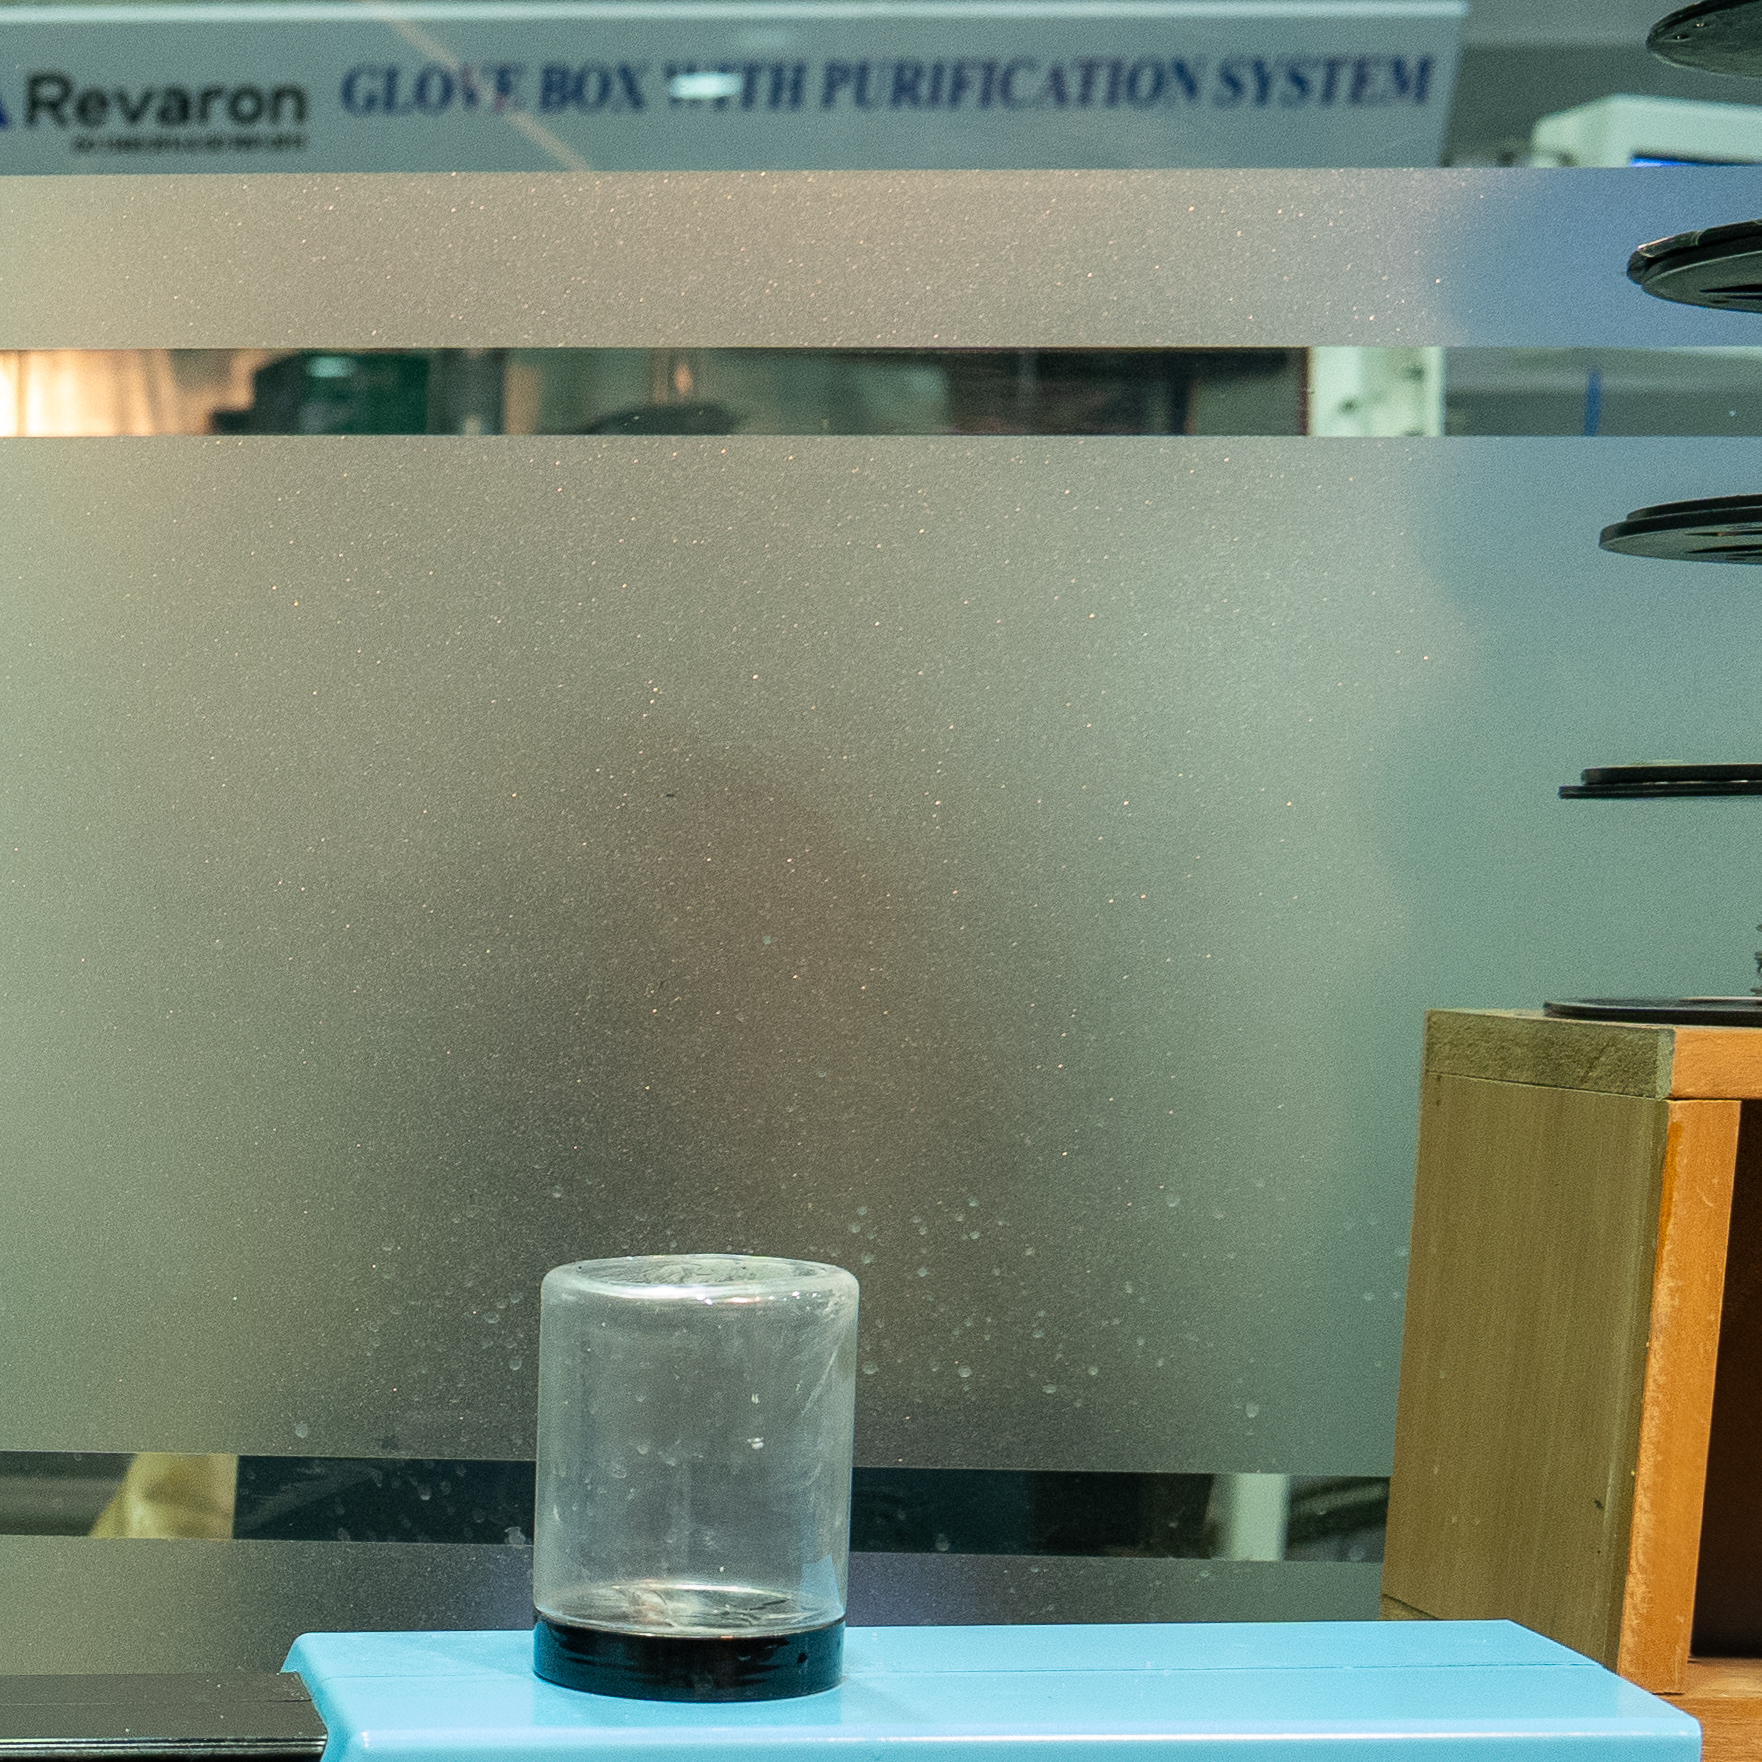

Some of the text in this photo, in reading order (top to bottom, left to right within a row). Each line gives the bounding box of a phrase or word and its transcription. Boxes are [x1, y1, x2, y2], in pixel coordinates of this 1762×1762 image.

[26, 70, 308, 127] Revaron
[538, 60, 648, 114] BOX
[820, 53, 1200, 111] PURIFICATION
[1216, 50, 1435, 109] SYSTEM
